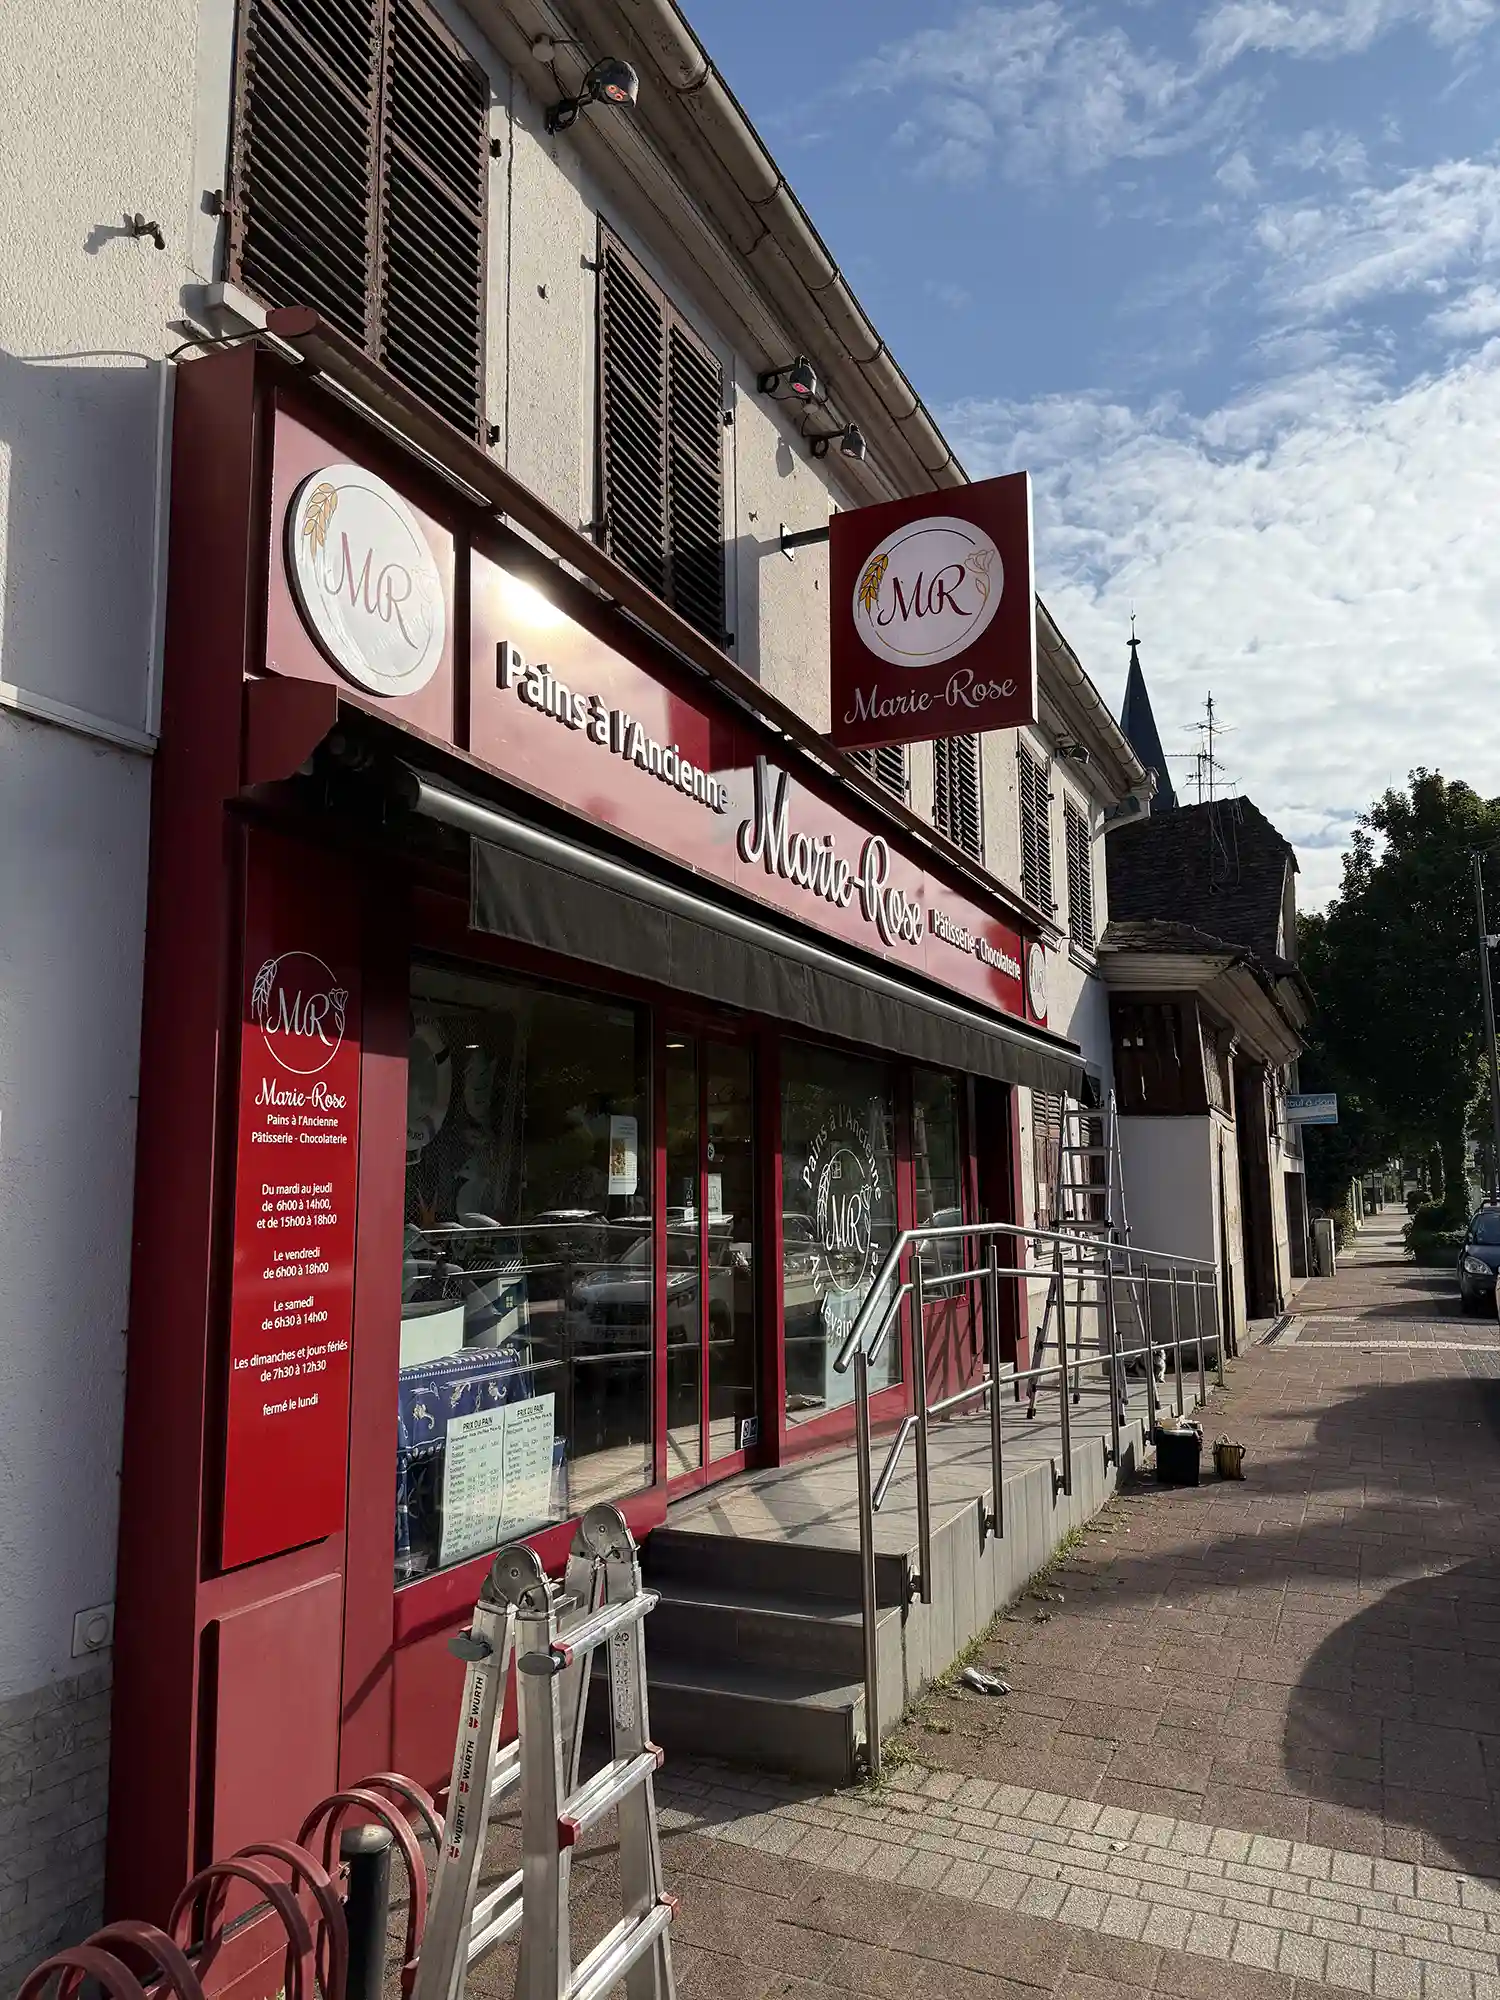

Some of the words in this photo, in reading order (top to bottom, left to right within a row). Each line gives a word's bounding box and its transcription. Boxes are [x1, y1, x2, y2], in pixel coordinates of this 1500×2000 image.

[324, 531, 419, 650] MR
[876, 563, 973, 627] MR
[843, 668, 1017, 724] Marie-Rose
[496, 641, 586, 731] Pains
[586, 695, 609, 745] à
[609, 710, 728, 814] l'Ancienne
[736, 754, 925, 947] Marie-Rose
[928, 908, 976, 955] Pâtisserie
[976, 937, 1021, 981] Chocolaterie
[265, 987, 334, 1047] MR
[254, 1077, 347, 1112] Marie-Rose
[266, 1114, 290, 1126] Pains
[291, 1115, 297, 1126] à
[298, 1115, 339, 1127] l'Ancienne
[251, 1131, 293, 1143] Pâtisserie
[299, 1133, 348, 1145] Chocolaterie
[802, 1123, 828, 1190] Pains
[829, 1108, 837, 1132] à
[838, 1103, 882, 1203] l'Ancienne
[261, 1183, 275, 1195] Du
[276, 1182, 300, 1195] mardi
[301, 1185, 311, 1194] au
[312, 1182, 333, 1197] jeudi
[261, 1200, 273, 1212] de
[276, 1199, 298, 1212] 6h00
[299, 1199, 304, 1210] à
[305, 1198, 332, 1211] 14h00,
[256, 1218, 266, 1229] et
[267, 1217, 279, 1228] de
[280, 1215, 306, 1228] 15h00
[306, 1214, 312, 1226] à
[313, 1213, 338, 1226] 18h00
[826, 1193, 866, 1254] MR
[273, 1250, 284, 1262] Le
[284, 1246, 321, 1261] vendredi
[263, 1267, 275, 1280] de
[275, 1265, 297, 1278] 6h00
[297, 1264, 303, 1276] à
[304, 1262, 329, 1275] 18h00
[809, 1254, 822, 1295] Au
[273, 1300, 284, 1312] Le
[284, 1295, 315, 1311] samedi
[261, 1318, 274, 1331] de
[274, 1315, 296, 1329] 6h30
[296, 1313, 302, 1325] à
[303, 1310, 328, 1324] 14h00
[233, 1357, 249, 1370] Les
[250, 1349, 296, 1367] dimanches
[296, 1347, 306, 1359] et
[305, 1344, 327, 1360] jours
[327, 1339, 348, 1353] fériés
[260, 1369, 272, 1383] de
[272, 1365, 294, 1380] 7h30
[295, 1363, 301, 1375] à
[302, 1359, 327, 1374] 12h30
[262, 1399, 288, 1416] fermé
[288, 1398, 297, 1410] le
[297, 1393, 319, 1408] lundi
